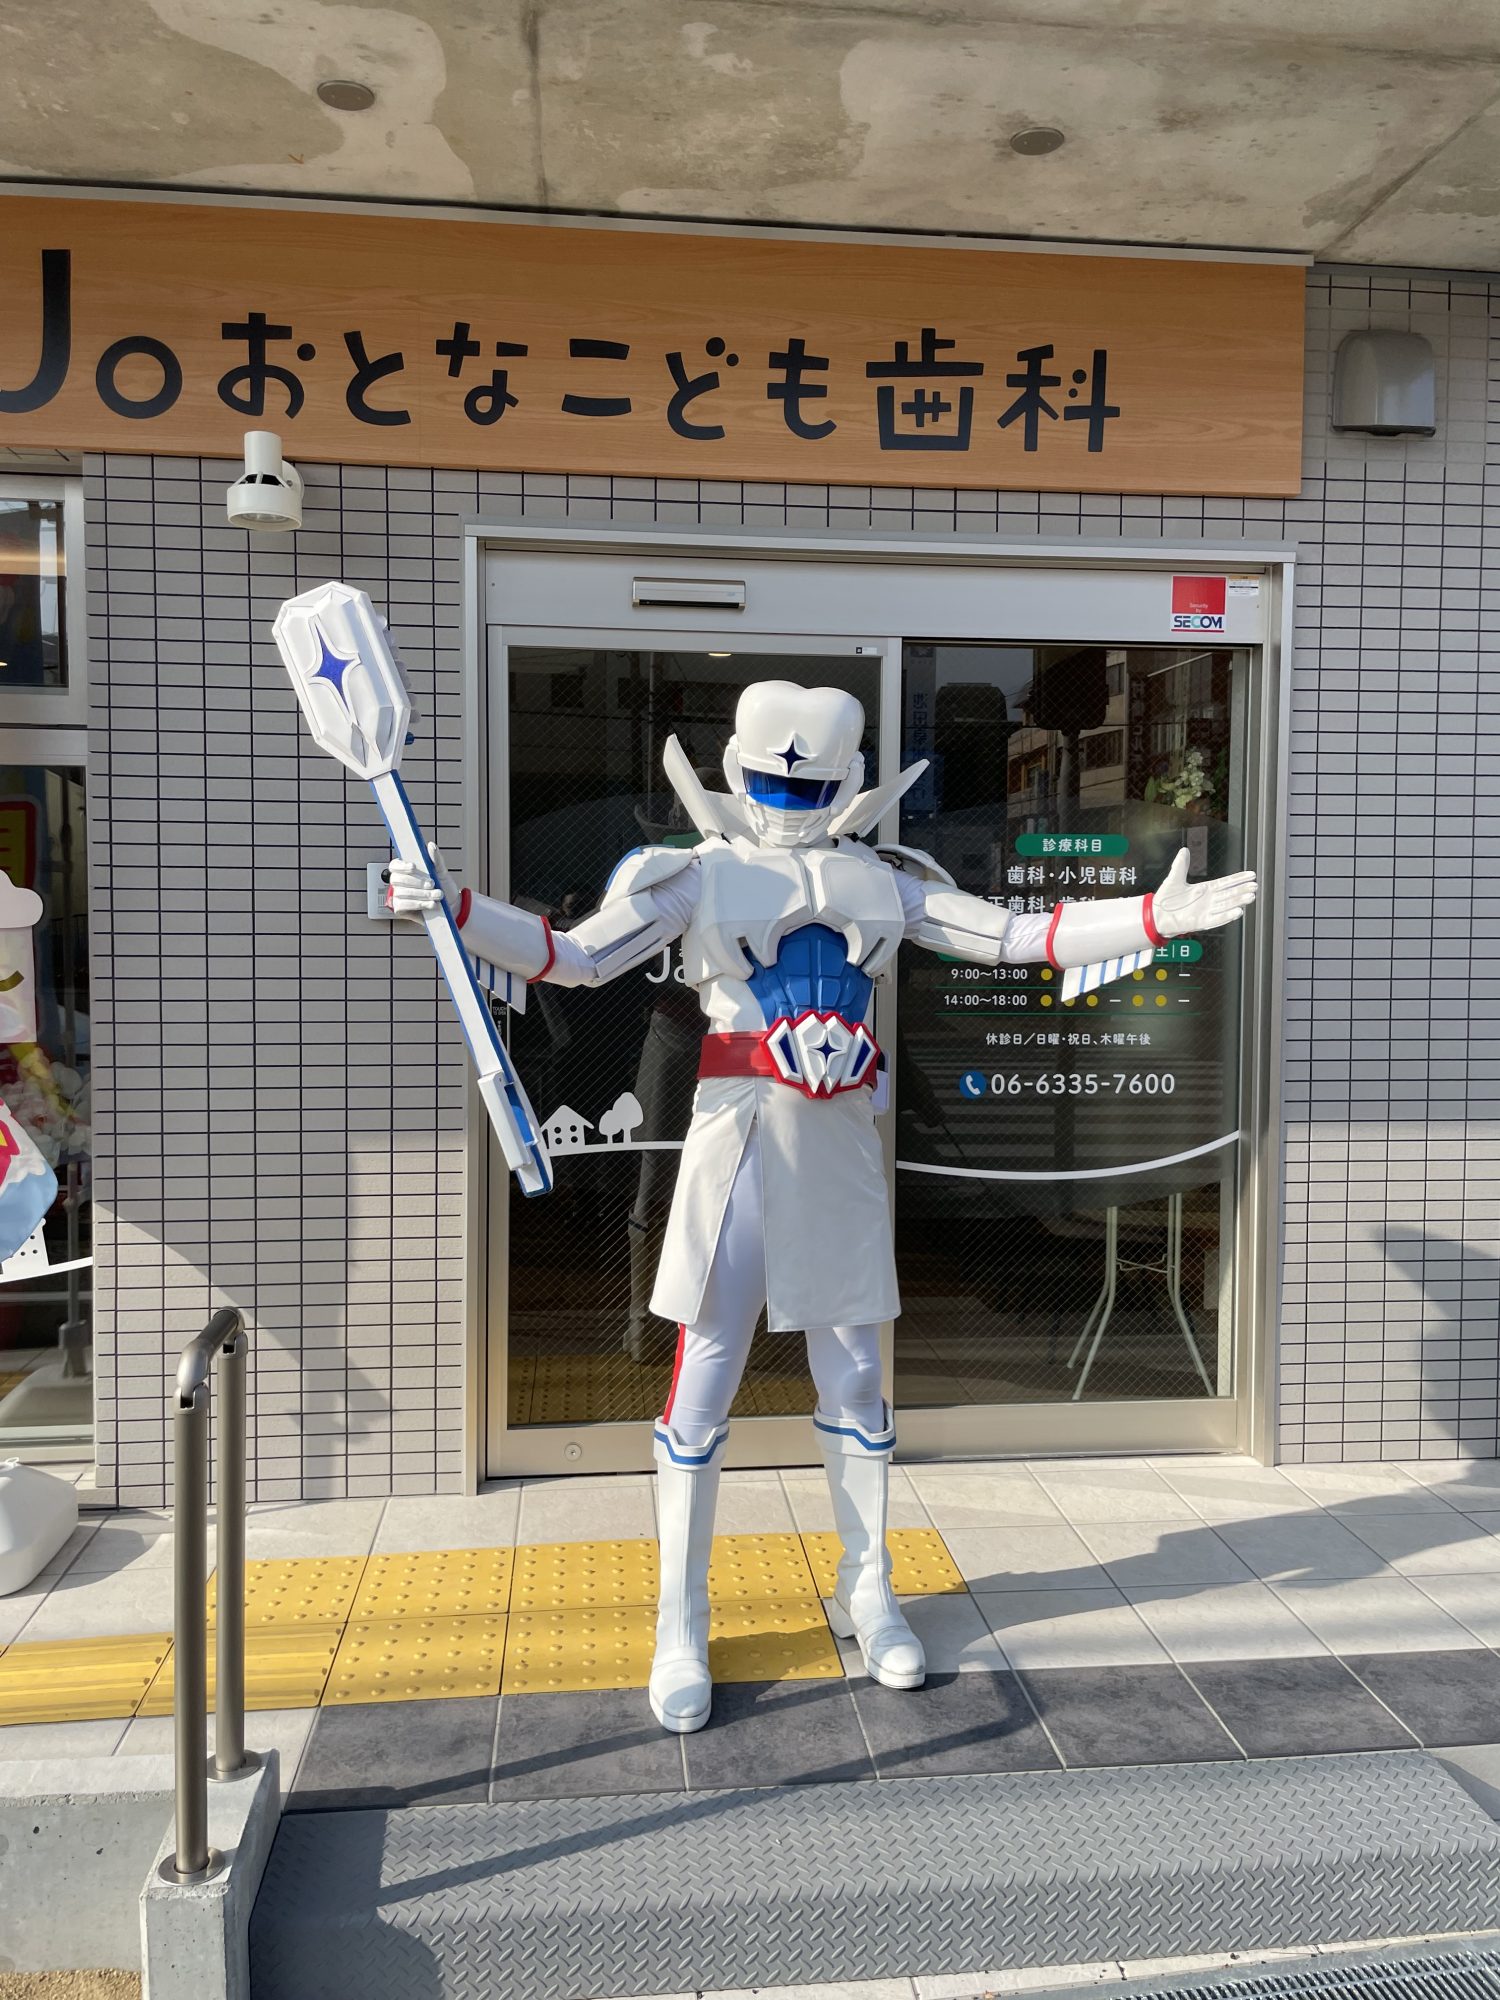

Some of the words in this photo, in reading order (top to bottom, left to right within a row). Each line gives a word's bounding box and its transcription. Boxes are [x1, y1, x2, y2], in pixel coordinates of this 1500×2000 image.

[1173, 615, 1223, 629] SECOM
[1042, 838, 1102, 853] 診療科目
[1007, 865, 1137, 885] 歯科・小児歯科
[1155, 946, 1169, 957] 土
[1180, 945, 1190, 957] 日
[991, 1073, 1175, 1095] 06-6335-7600
